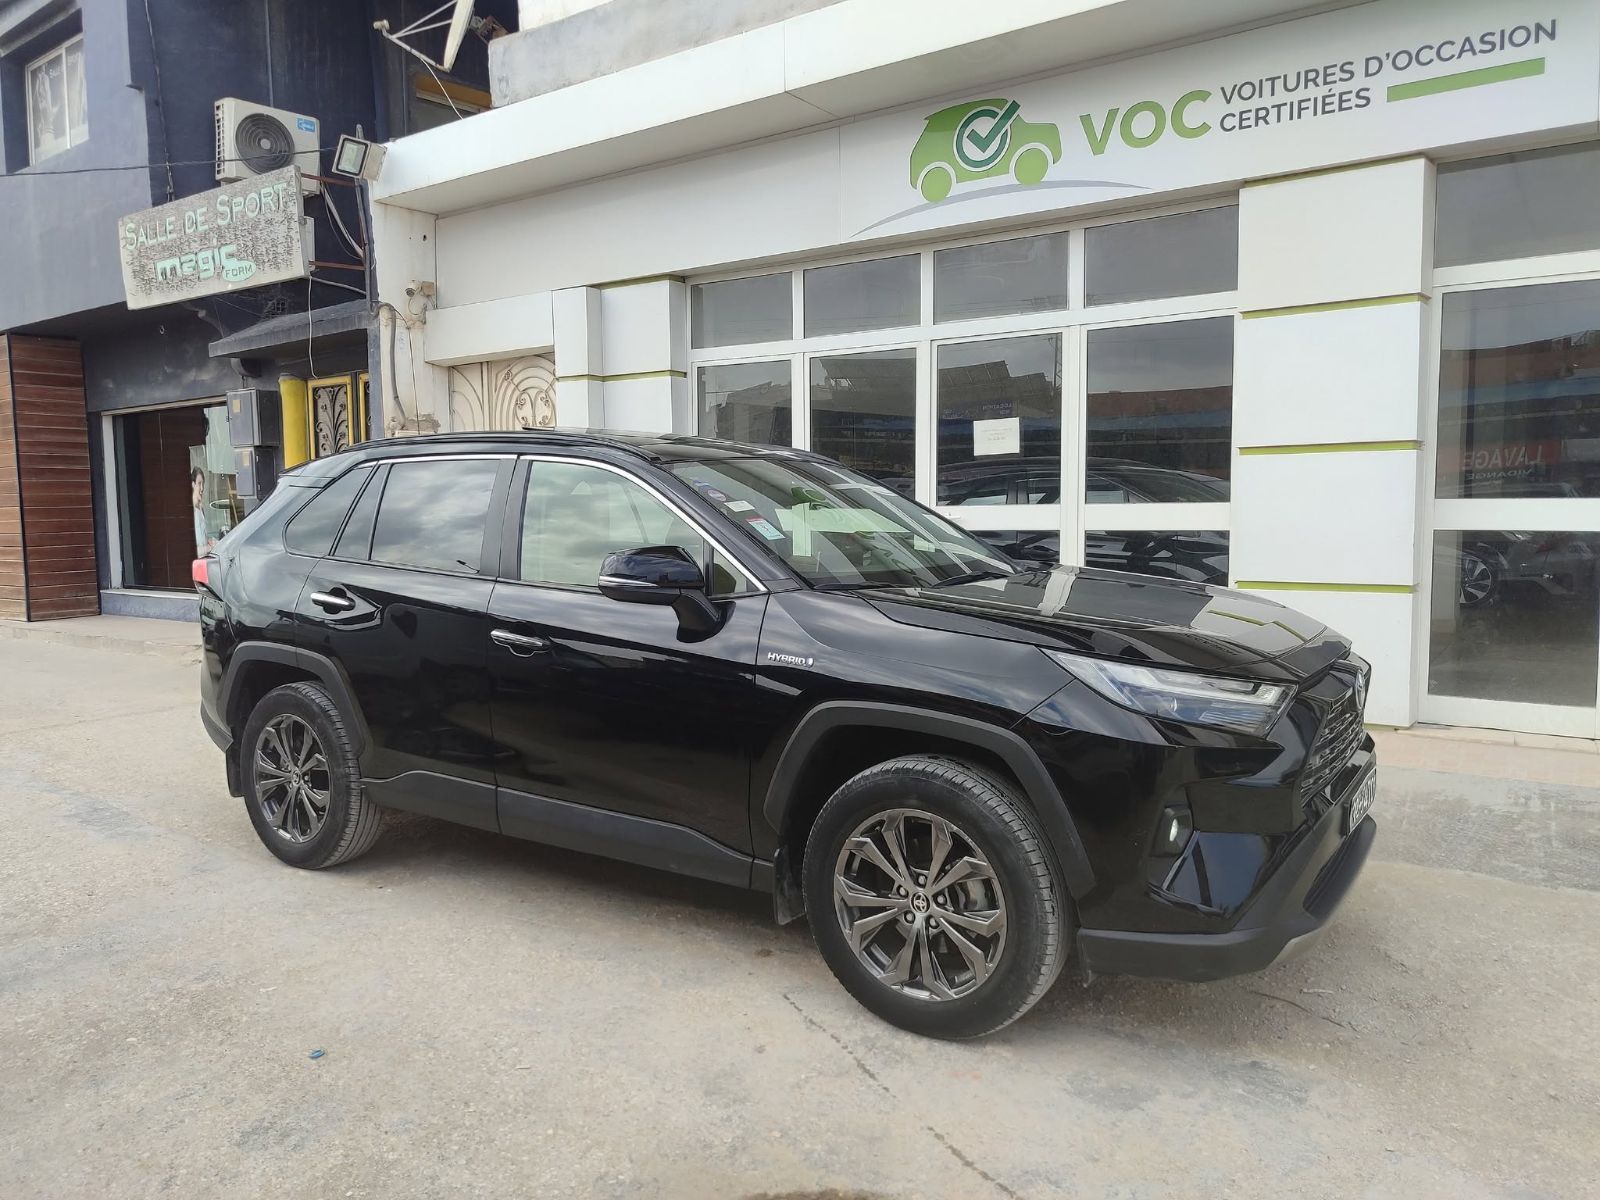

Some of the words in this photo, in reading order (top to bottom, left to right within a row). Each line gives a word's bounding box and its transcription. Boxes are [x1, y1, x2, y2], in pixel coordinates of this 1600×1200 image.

[1219, 60, 1355, 105] VOITURES
[1364, 19, 1557, 79] D'OCCASION
[1079, 89, 1213, 157] VOC
[1219, 87, 1371, 133] CERTIFIÉES
[125, 216, 177, 250] SALLE
[183, 207, 209, 235] DE
[216, 182, 288, 226] SPORT
[225, 264, 253, 278] FORM
[767, 651, 806, 665] HYBRID
